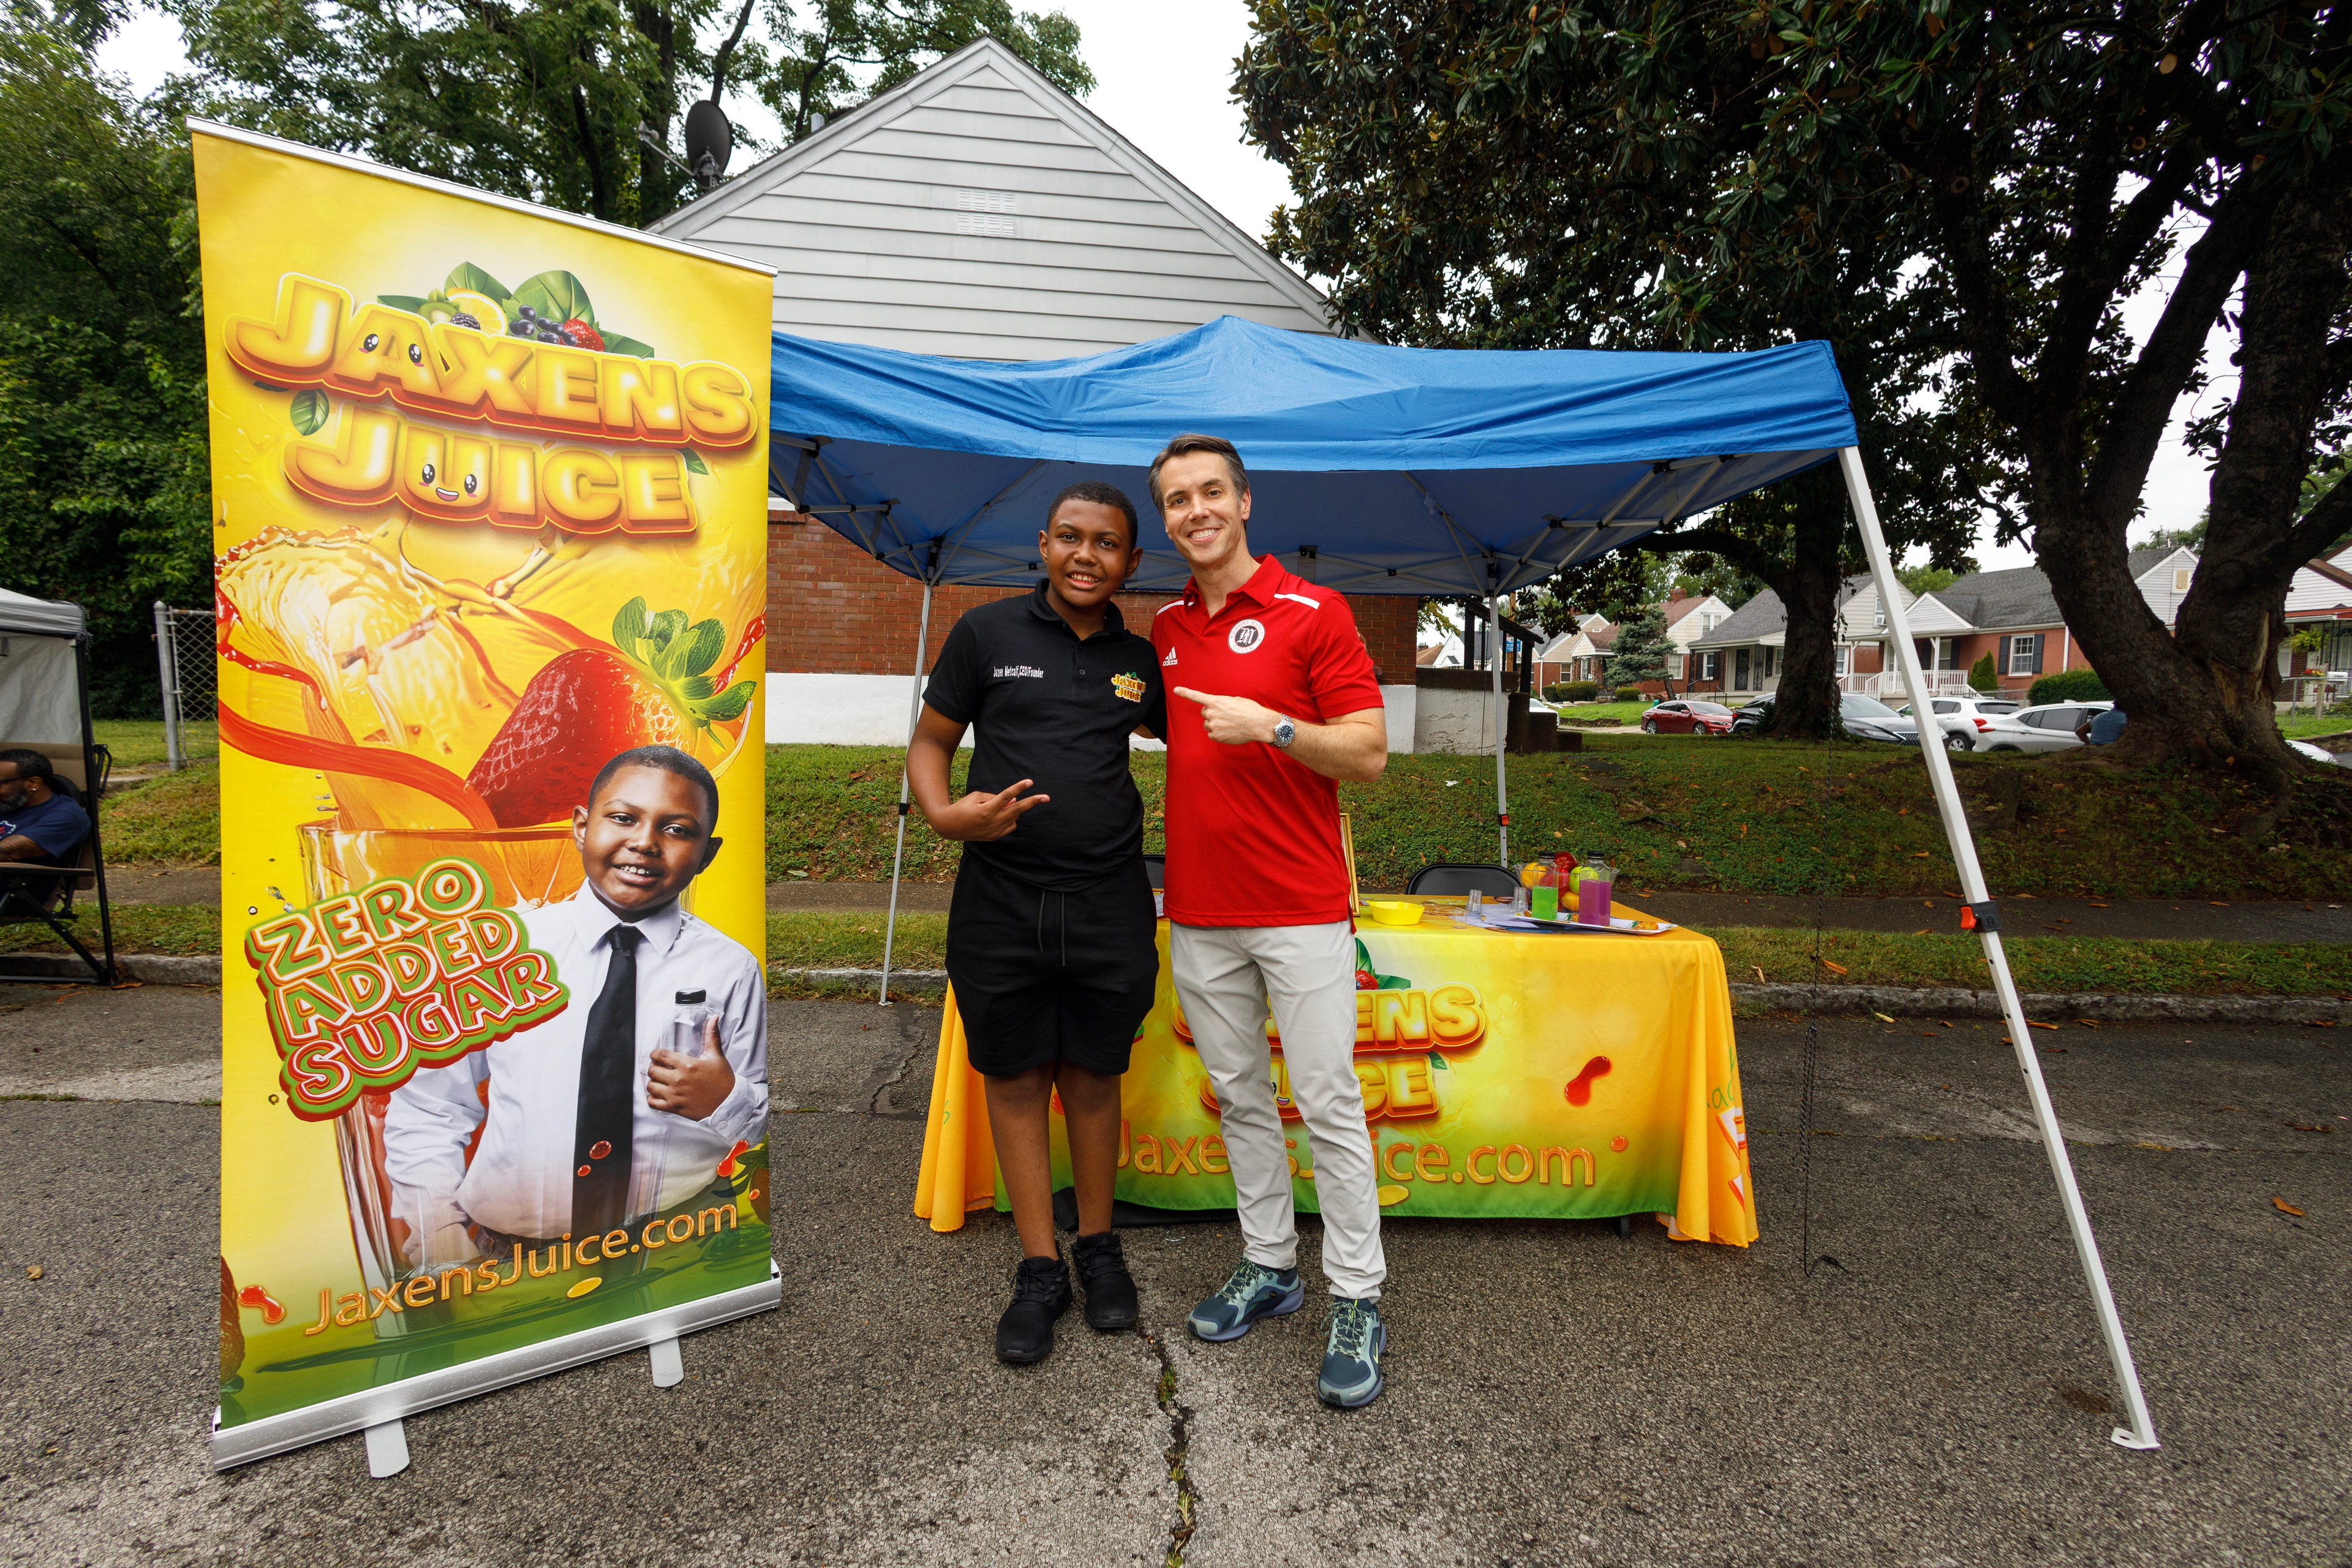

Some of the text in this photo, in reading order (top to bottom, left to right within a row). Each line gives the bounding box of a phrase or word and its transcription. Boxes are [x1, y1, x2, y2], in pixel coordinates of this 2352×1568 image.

[224, 273, 757, 450] JAXENS
[284, 402, 697, 537] JUICE
[1111, 674, 1146, 693] JAXENS
[1115, 685, 1141, 703] JUICE
[252, 858, 486, 982] ZERO
[274, 909, 522, 1046] ADDED
[288, 949, 564, 1105] SUGAR
[304, 1200, 737, 1336] JaxensJuice.com
